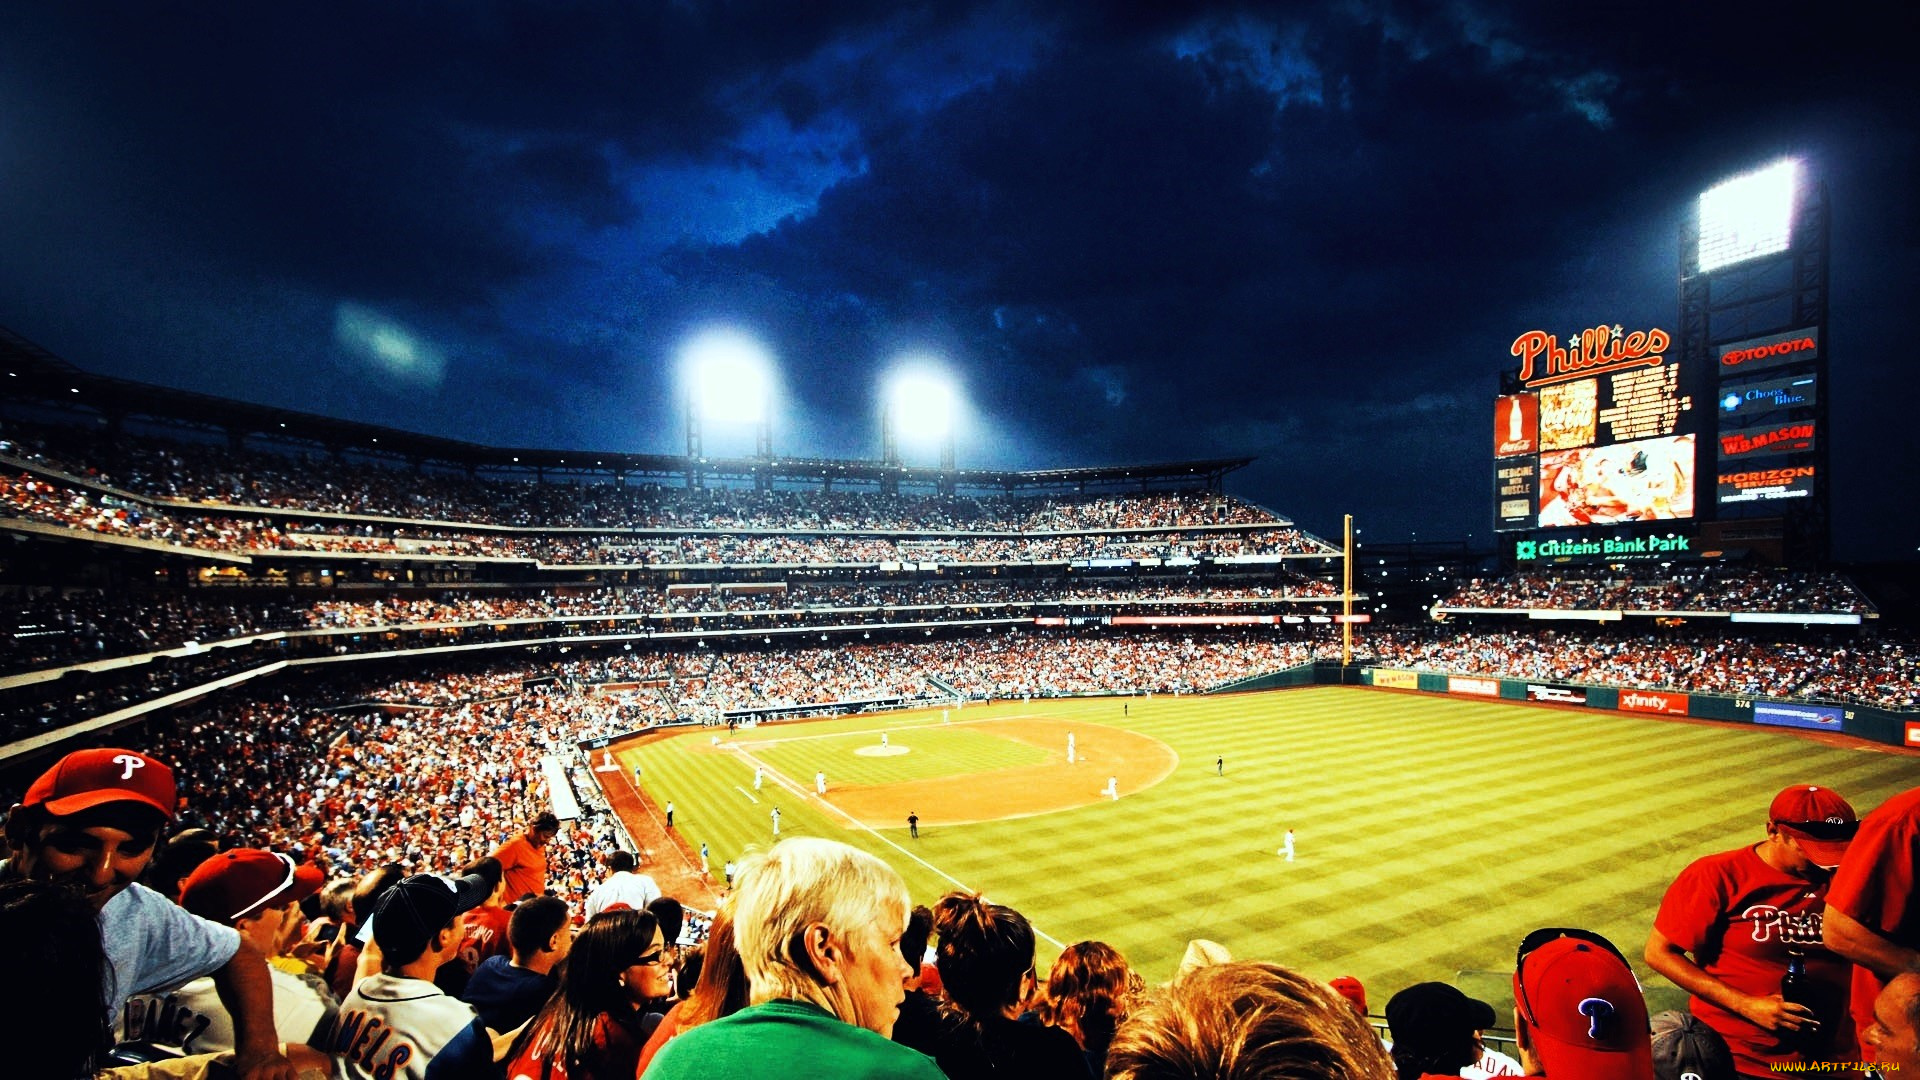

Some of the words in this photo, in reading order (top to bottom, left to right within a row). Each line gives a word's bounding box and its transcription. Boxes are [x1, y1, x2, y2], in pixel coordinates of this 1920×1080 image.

[1511, 324, 1670, 381] Phillies
[1744, 338, 1815, 360] TOYOTA
[1746, 388, 1785, 401] Choos
[1718, 466, 1815, 485] HORIZON
[1734, 477, 1793, 489] SERVICES
[1501, 484, 1531, 496] MUSCLE
[1539, 540, 1601, 556] Citizens
[1603, 537, 1646, 554] Bank
[1649, 535, 1689, 551] Park
[1623, 692, 1668, 711] xfinity
[112, 754, 146, 780] P
